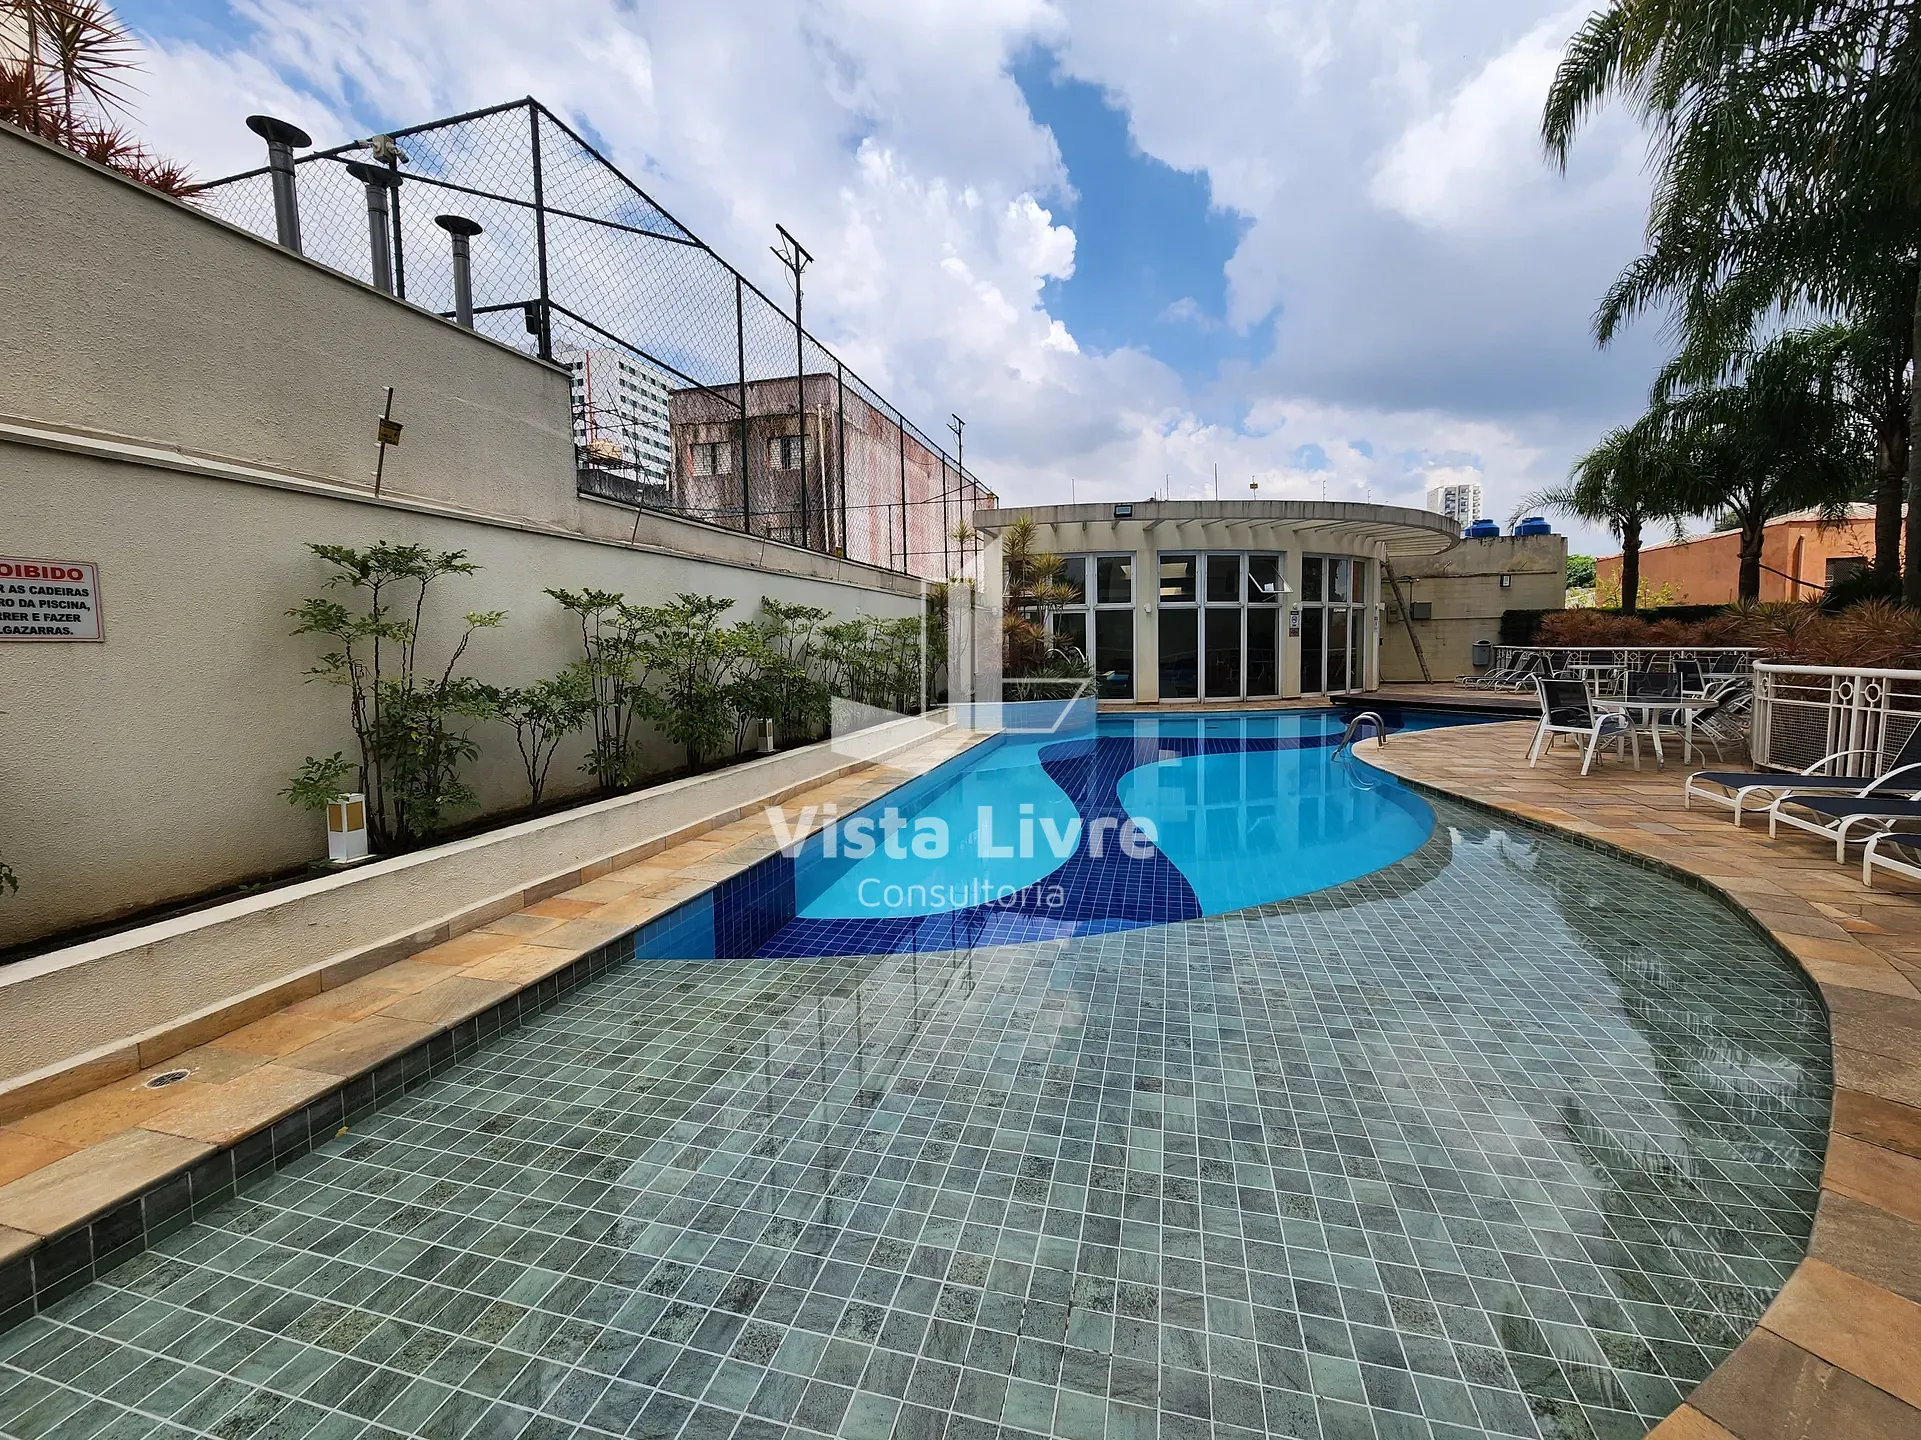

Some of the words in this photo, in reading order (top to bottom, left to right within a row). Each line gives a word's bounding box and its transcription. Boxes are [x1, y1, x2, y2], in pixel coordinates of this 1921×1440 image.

[0, 563, 84, 581] OIBIDO
[8, 584, 26, 594] AS
[28, 585, 90, 597] CADEIRAS
[18, 598, 36, 608] DA
[38, 599, 91, 611] PISCINA,
[31, 612, 40, 621] E
[43, 613, 81, 622] FAZER
